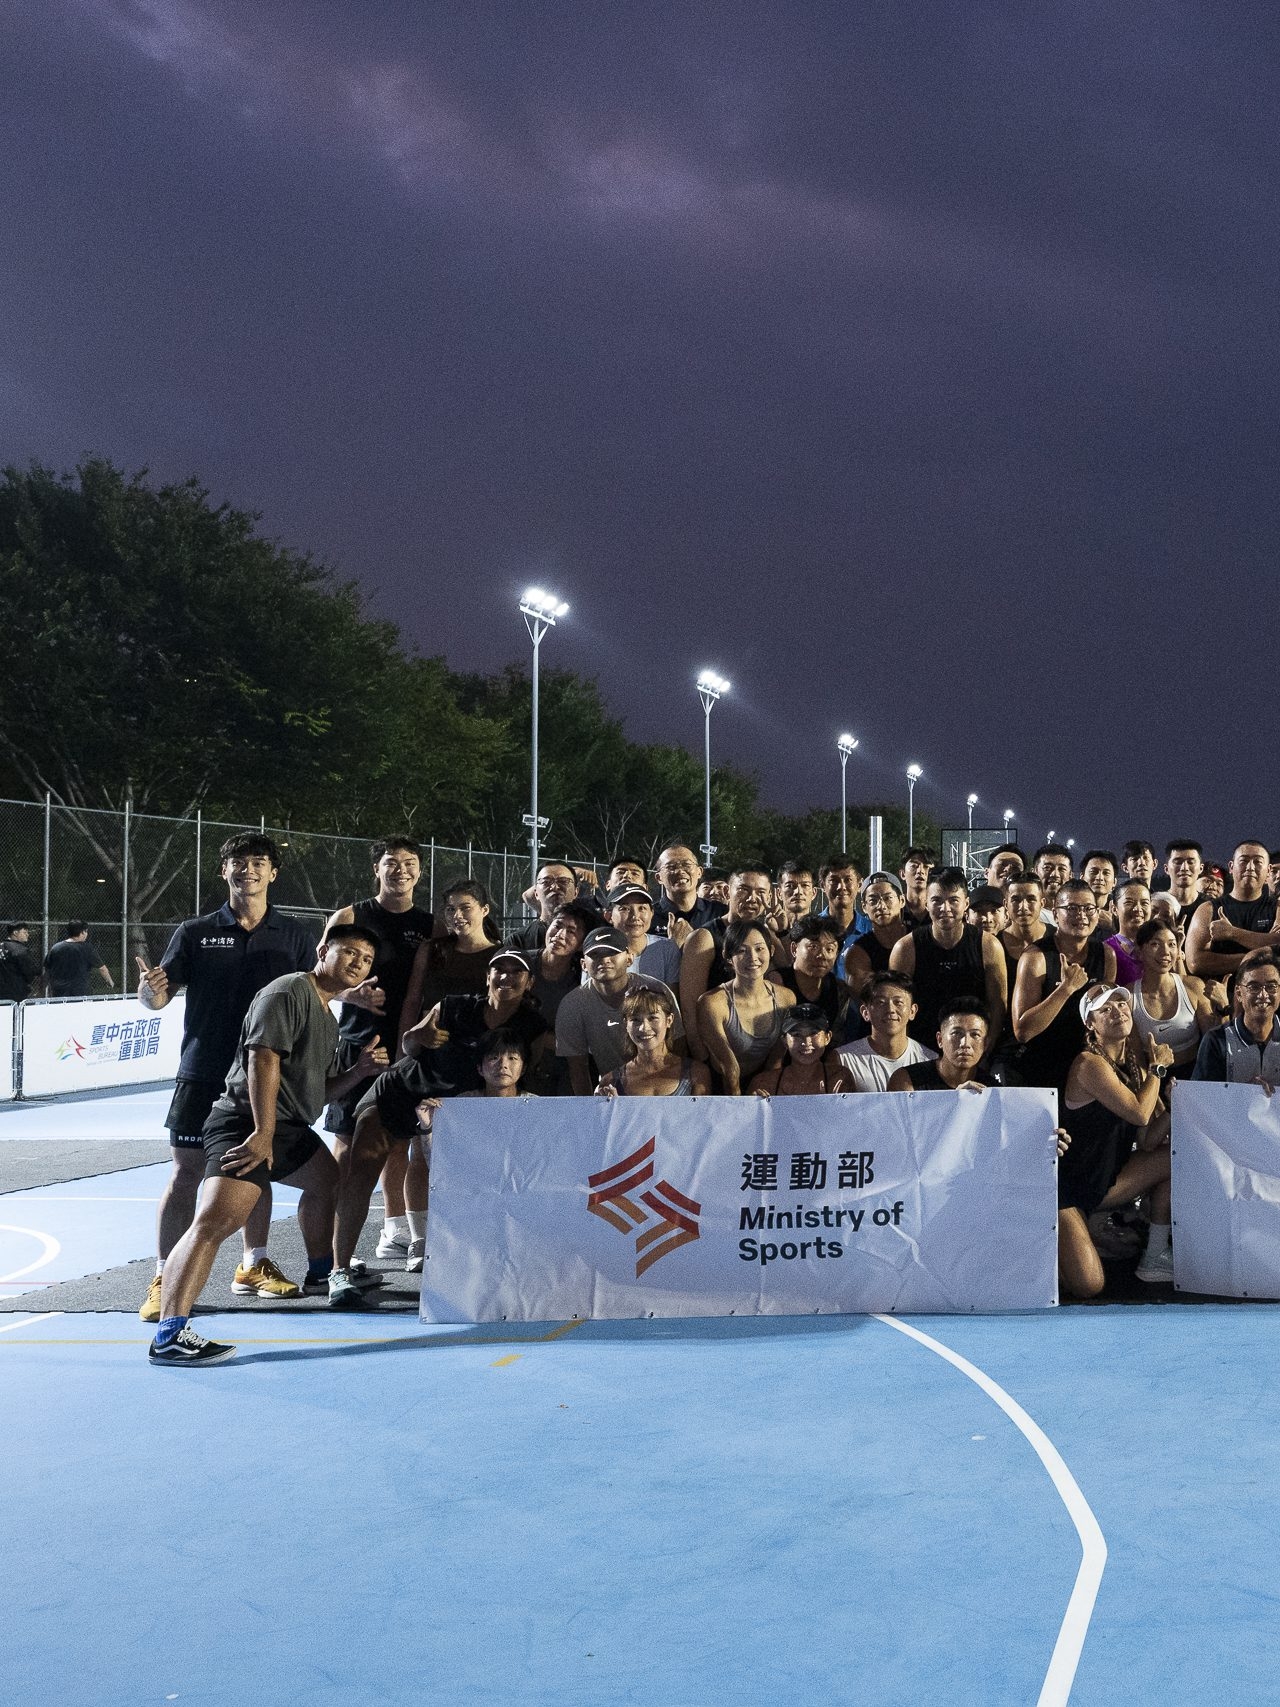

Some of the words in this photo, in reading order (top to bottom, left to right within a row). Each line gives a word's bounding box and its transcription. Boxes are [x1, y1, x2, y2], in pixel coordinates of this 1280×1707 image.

[90, 1017, 162, 1046] 臺中市政府
[118, 1036, 160, 1061] 運動局
[740, 1151, 875, 1191] 運動部
[739, 1204, 865, 1233] Ministry
[872, 1201, 904, 1227] of
[738, 1237, 844, 1266] Sports
